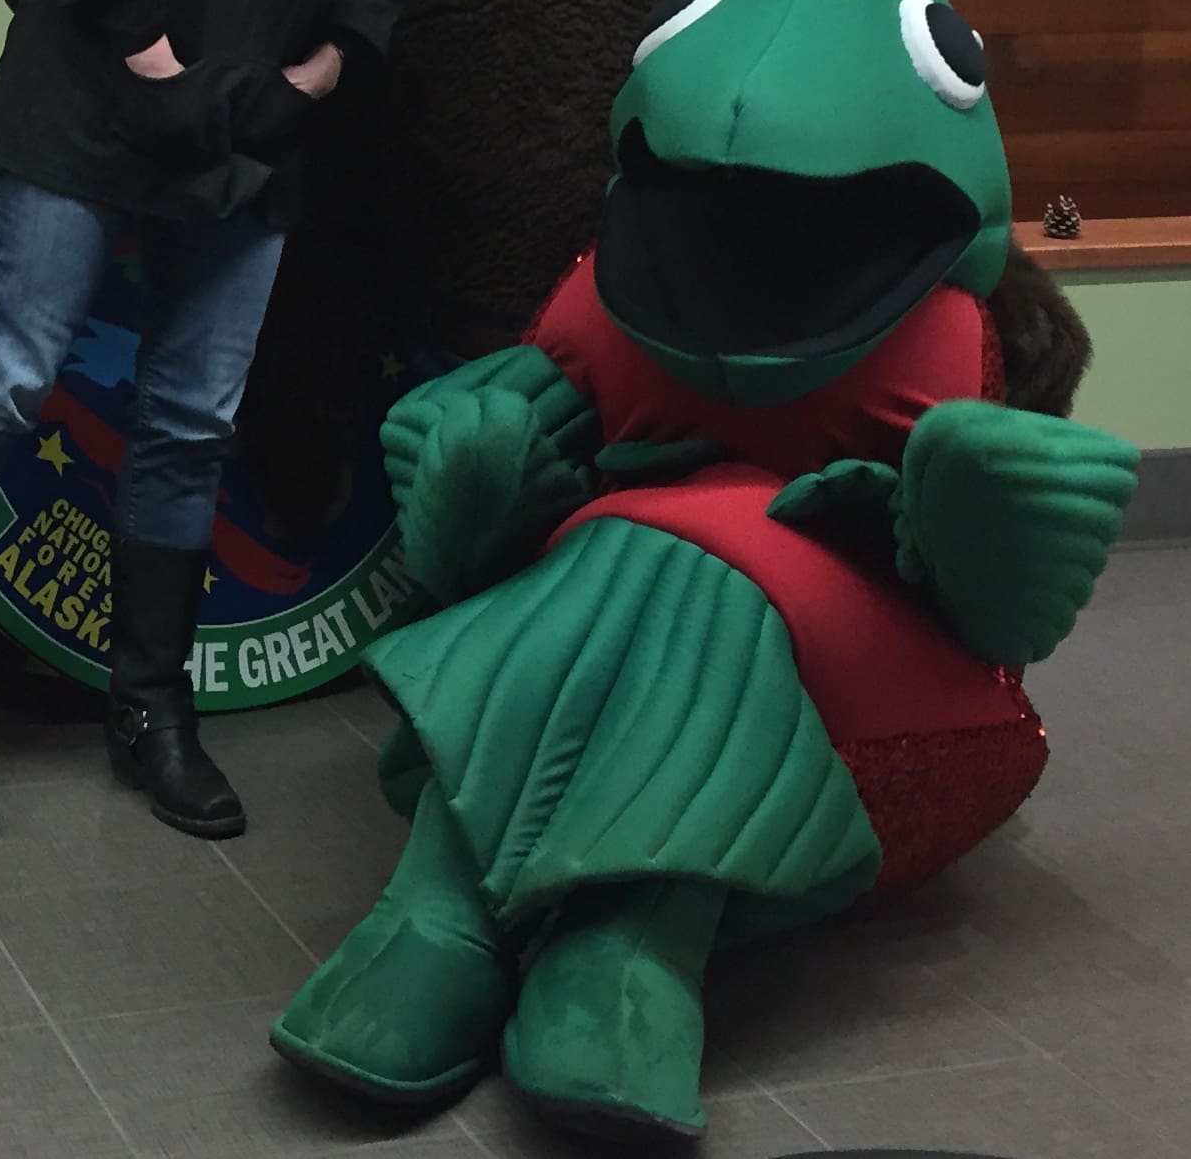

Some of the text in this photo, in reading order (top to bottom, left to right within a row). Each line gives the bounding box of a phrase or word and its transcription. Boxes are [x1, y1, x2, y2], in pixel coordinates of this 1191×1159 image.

[32, 509, 113, 577] NATION
[51, 498, 112, 558] CHUG
[17, 525, 114, 614] FORES
[183, 545, 416, 693] HE GREAT LAN
